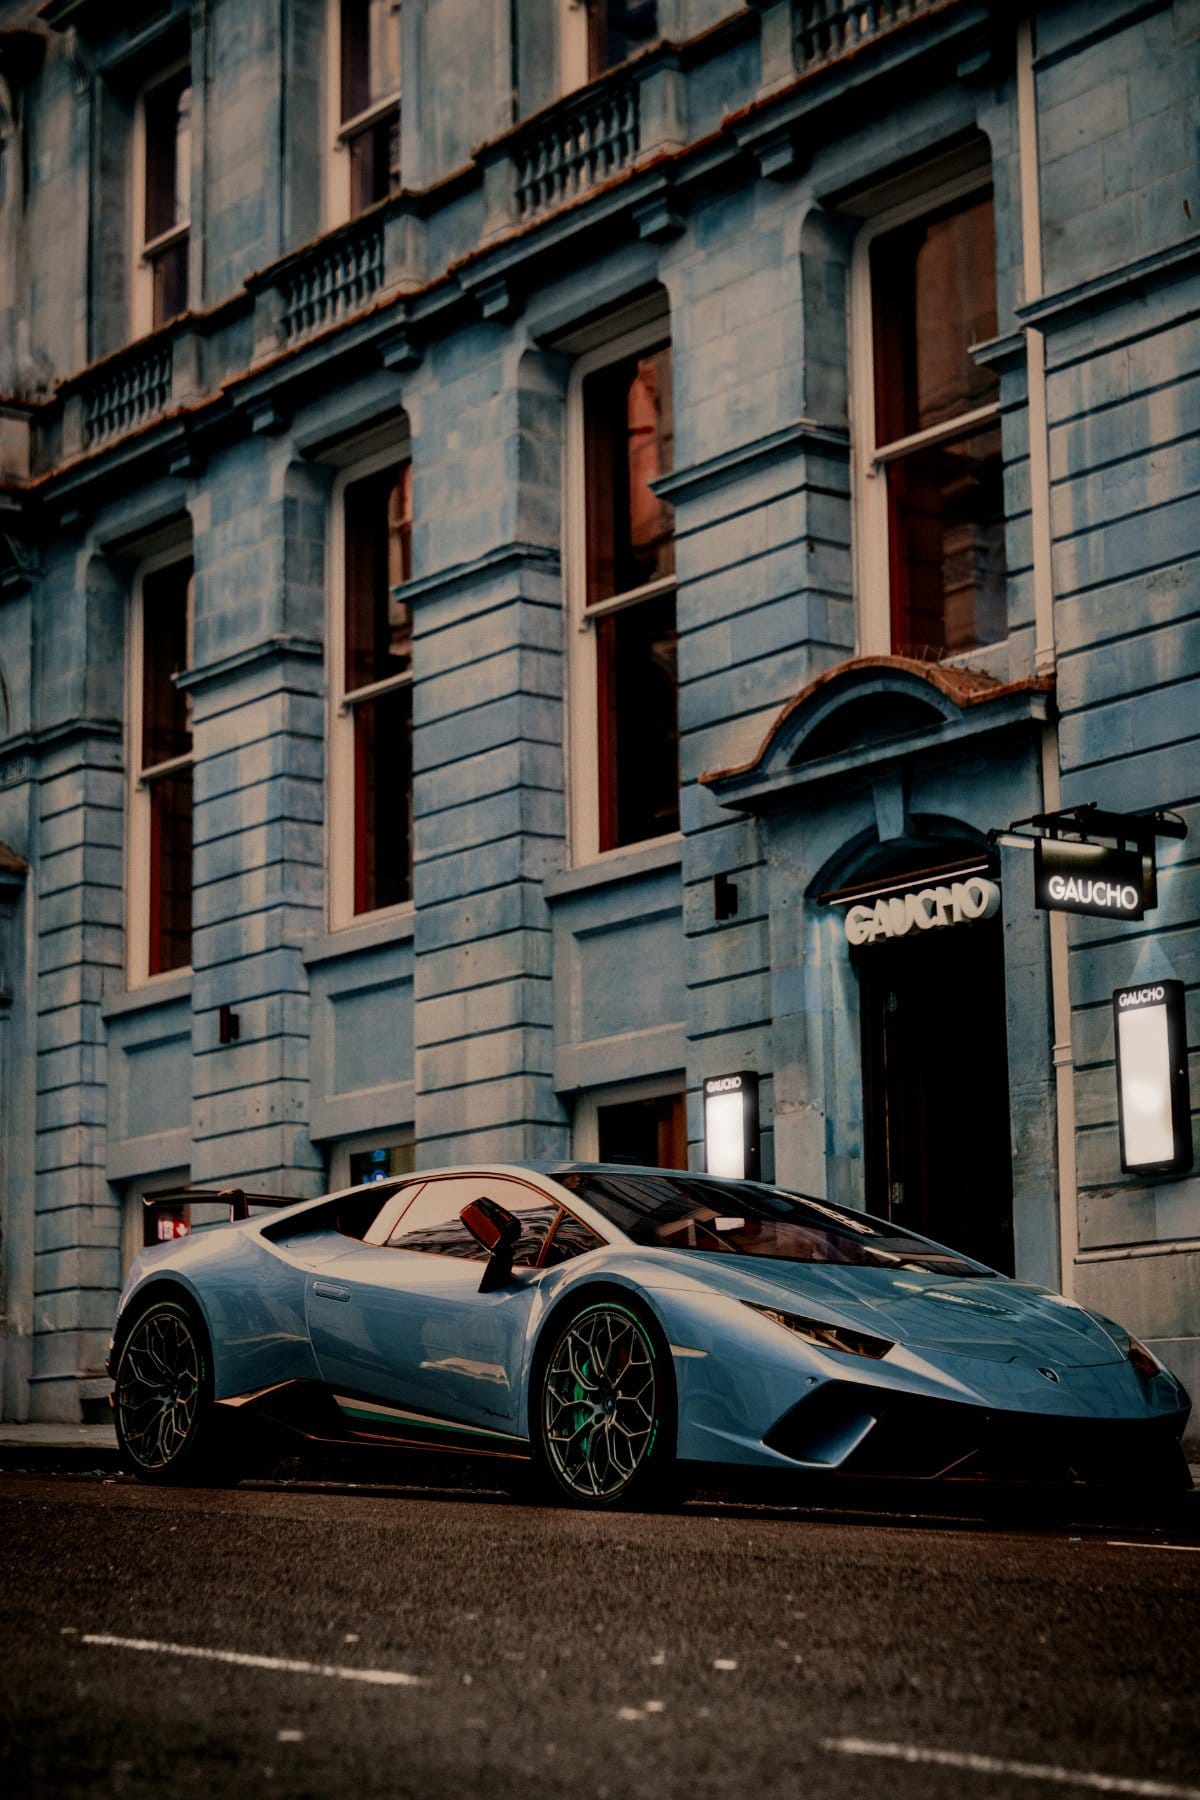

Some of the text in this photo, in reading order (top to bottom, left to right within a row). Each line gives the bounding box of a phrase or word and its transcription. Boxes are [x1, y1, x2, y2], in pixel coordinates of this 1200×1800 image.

[1048, 875, 1138, 910] GAUCHO
[845, 877, 1000, 945] GAUCHO
[1118, 986, 1165, 1007] GAUCHO
[706, 1076, 742, 1093] GAUCHO
